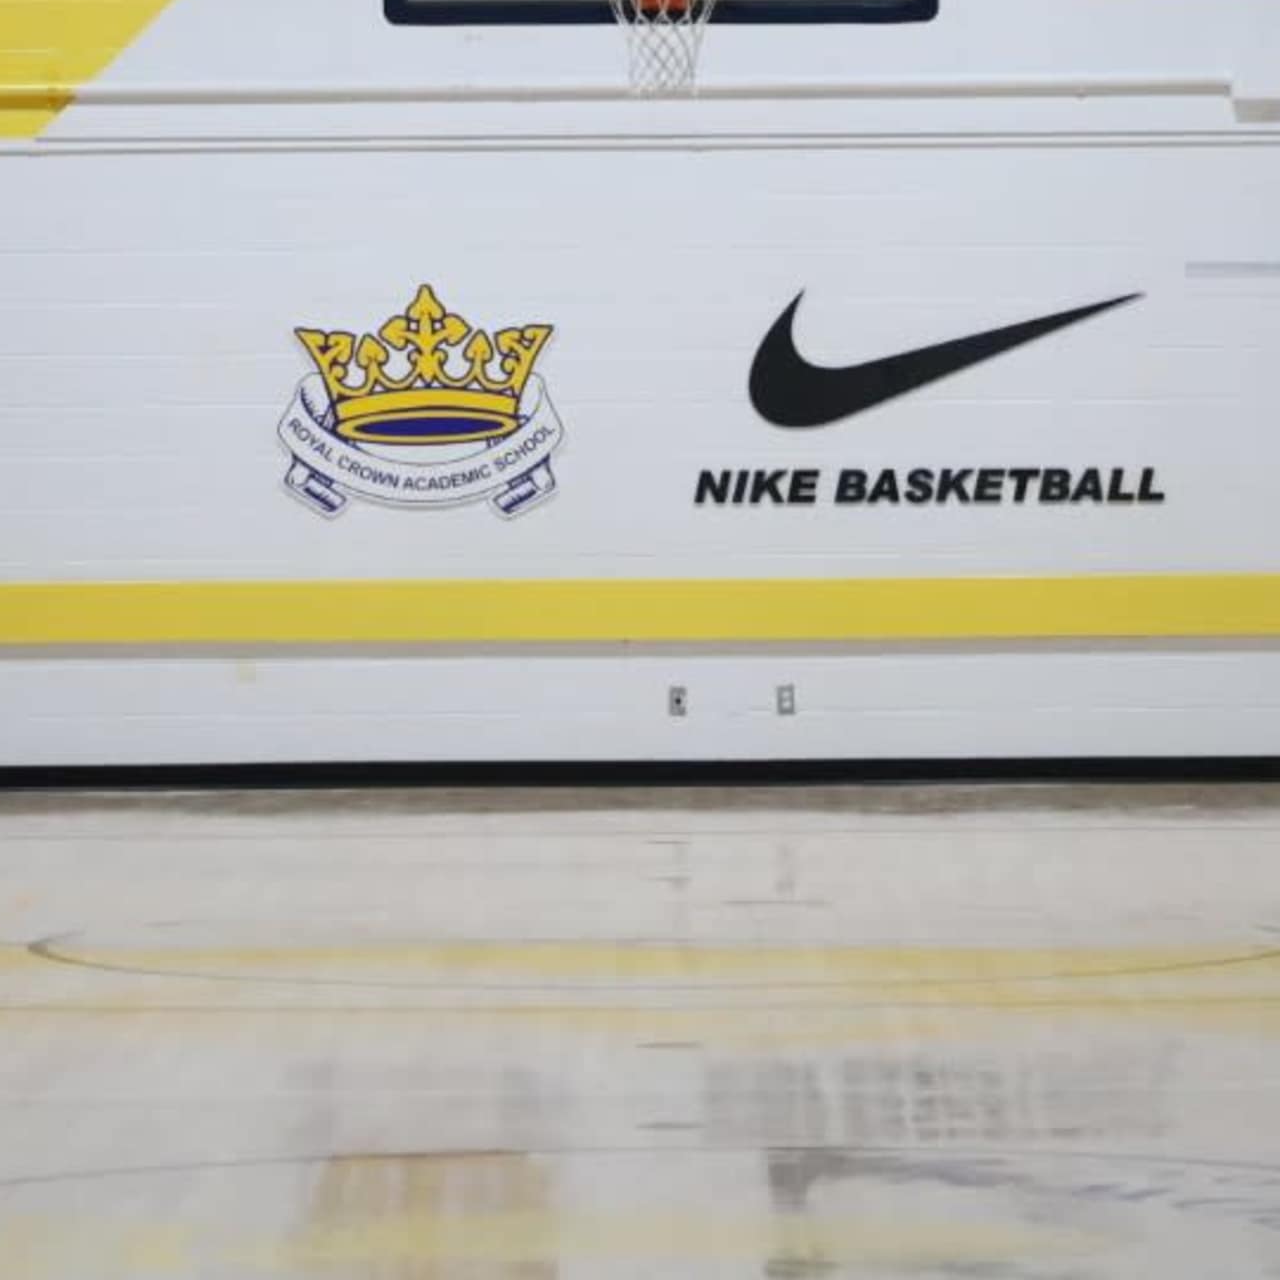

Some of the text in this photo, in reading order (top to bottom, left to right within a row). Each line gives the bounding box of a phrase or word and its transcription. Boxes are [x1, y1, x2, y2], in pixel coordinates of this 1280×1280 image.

[287, 418, 556, 491] ROYAL CROWN ACADEMIC SCHOOL
[693, 468, 1166, 505] NIKE BASKETBALL
